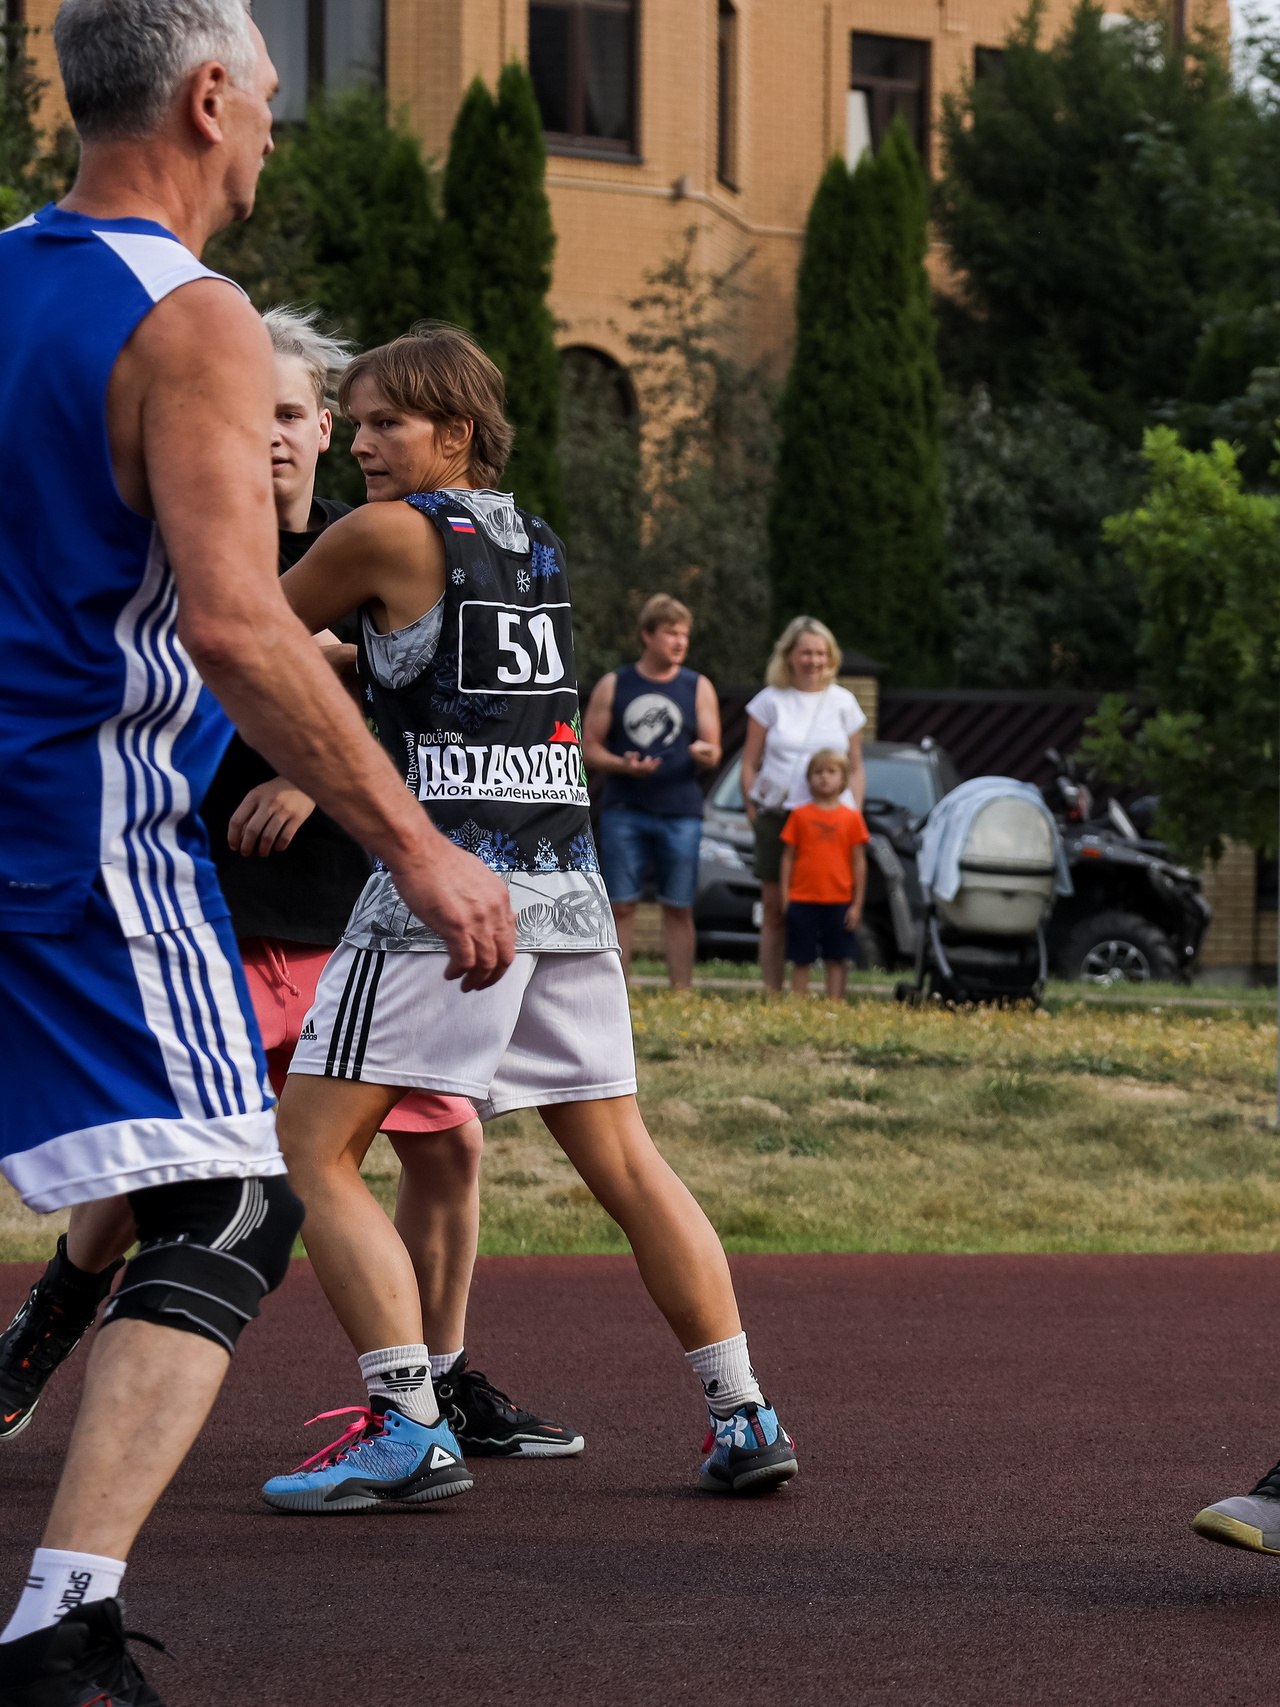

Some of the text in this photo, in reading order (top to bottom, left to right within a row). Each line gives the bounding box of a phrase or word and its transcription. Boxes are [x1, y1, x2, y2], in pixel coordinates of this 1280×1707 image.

[497, 612, 564, 684] 50
[418, 729, 464, 745] посёлок
[418, 743, 580, 786] ПОТАПОВО
[426, 783, 471, 797] Моя
[478, 786, 568, 800] маленькая
